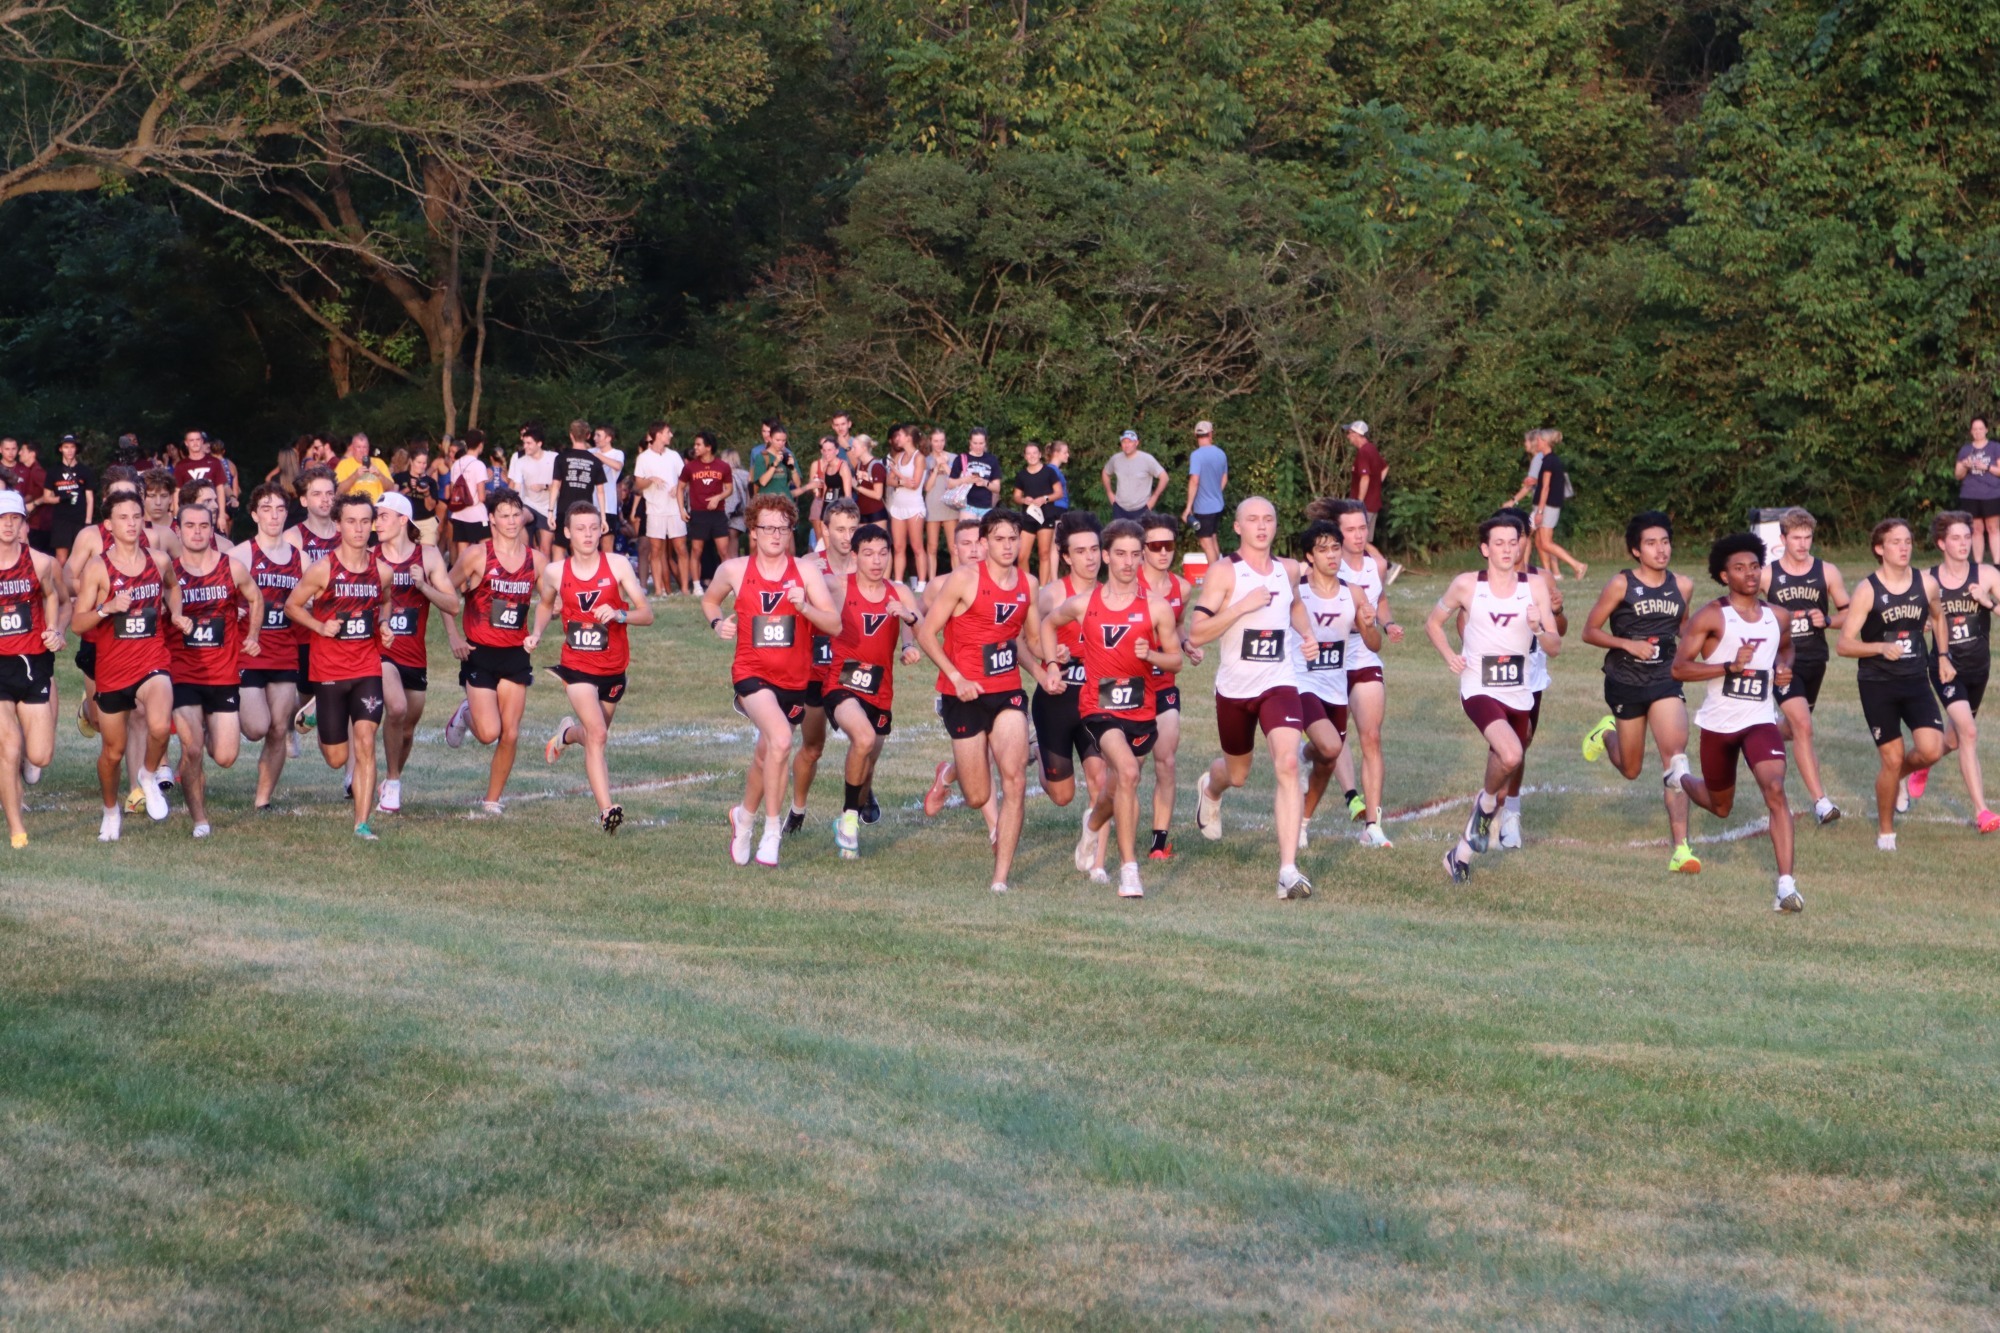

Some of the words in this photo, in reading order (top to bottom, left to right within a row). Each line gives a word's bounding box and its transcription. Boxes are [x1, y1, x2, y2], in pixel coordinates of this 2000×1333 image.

[692, 470, 722, 480] HOKIES
[0, 579, 31, 595] CHBURG
[115, 583, 160, 601] CHBURG
[335, 583, 378, 597] LYNCHBURG
[491, 578, 530, 594] LYNCHBURG
[576, 590, 601, 613] V
[759, 590, 785, 614] V
[1776, 586, 1821, 603] FERRUM
[994, 602, 1018, 624] V
[1634, 599, 1680, 617] FERRUM
[1881, 605, 1922, 624] FERRUM
[1941, 599, 1979, 615] ERRUM
[1, 614, 21, 630] 60
[268, 611, 284, 624] 51
[390, 616, 407, 630] 49
[500, 610, 517, 624] 45
[861, 612, 888, 636] V
[1313, 612, 1341, 627] VT
[1489, 612, 1519, 627] VT
[126, 618, 146, 633] 55
[347, 619, 365, 634] 56
[764, 625, 784, 640] 98
[1791, 618, 1809, 633] 28
[1952, 624, 1970, 640] 31
[193, 627, 213, 641] 44
[574, 630, 600, 645] 102
[1101, 624, 1131, 649] V
[1250, 639, 1277, 656] 121
[990, 650, 1013, 669] 103
[1315, 650, 1340, 665] 118
[851, 670, 872, 688] 99
[1067, 665, 1087, 681] 10
[1490, 664, 1518, 681] 119
[1732, 677, 1762, 695] 115
[1111, 688, 1133, 704] 97
